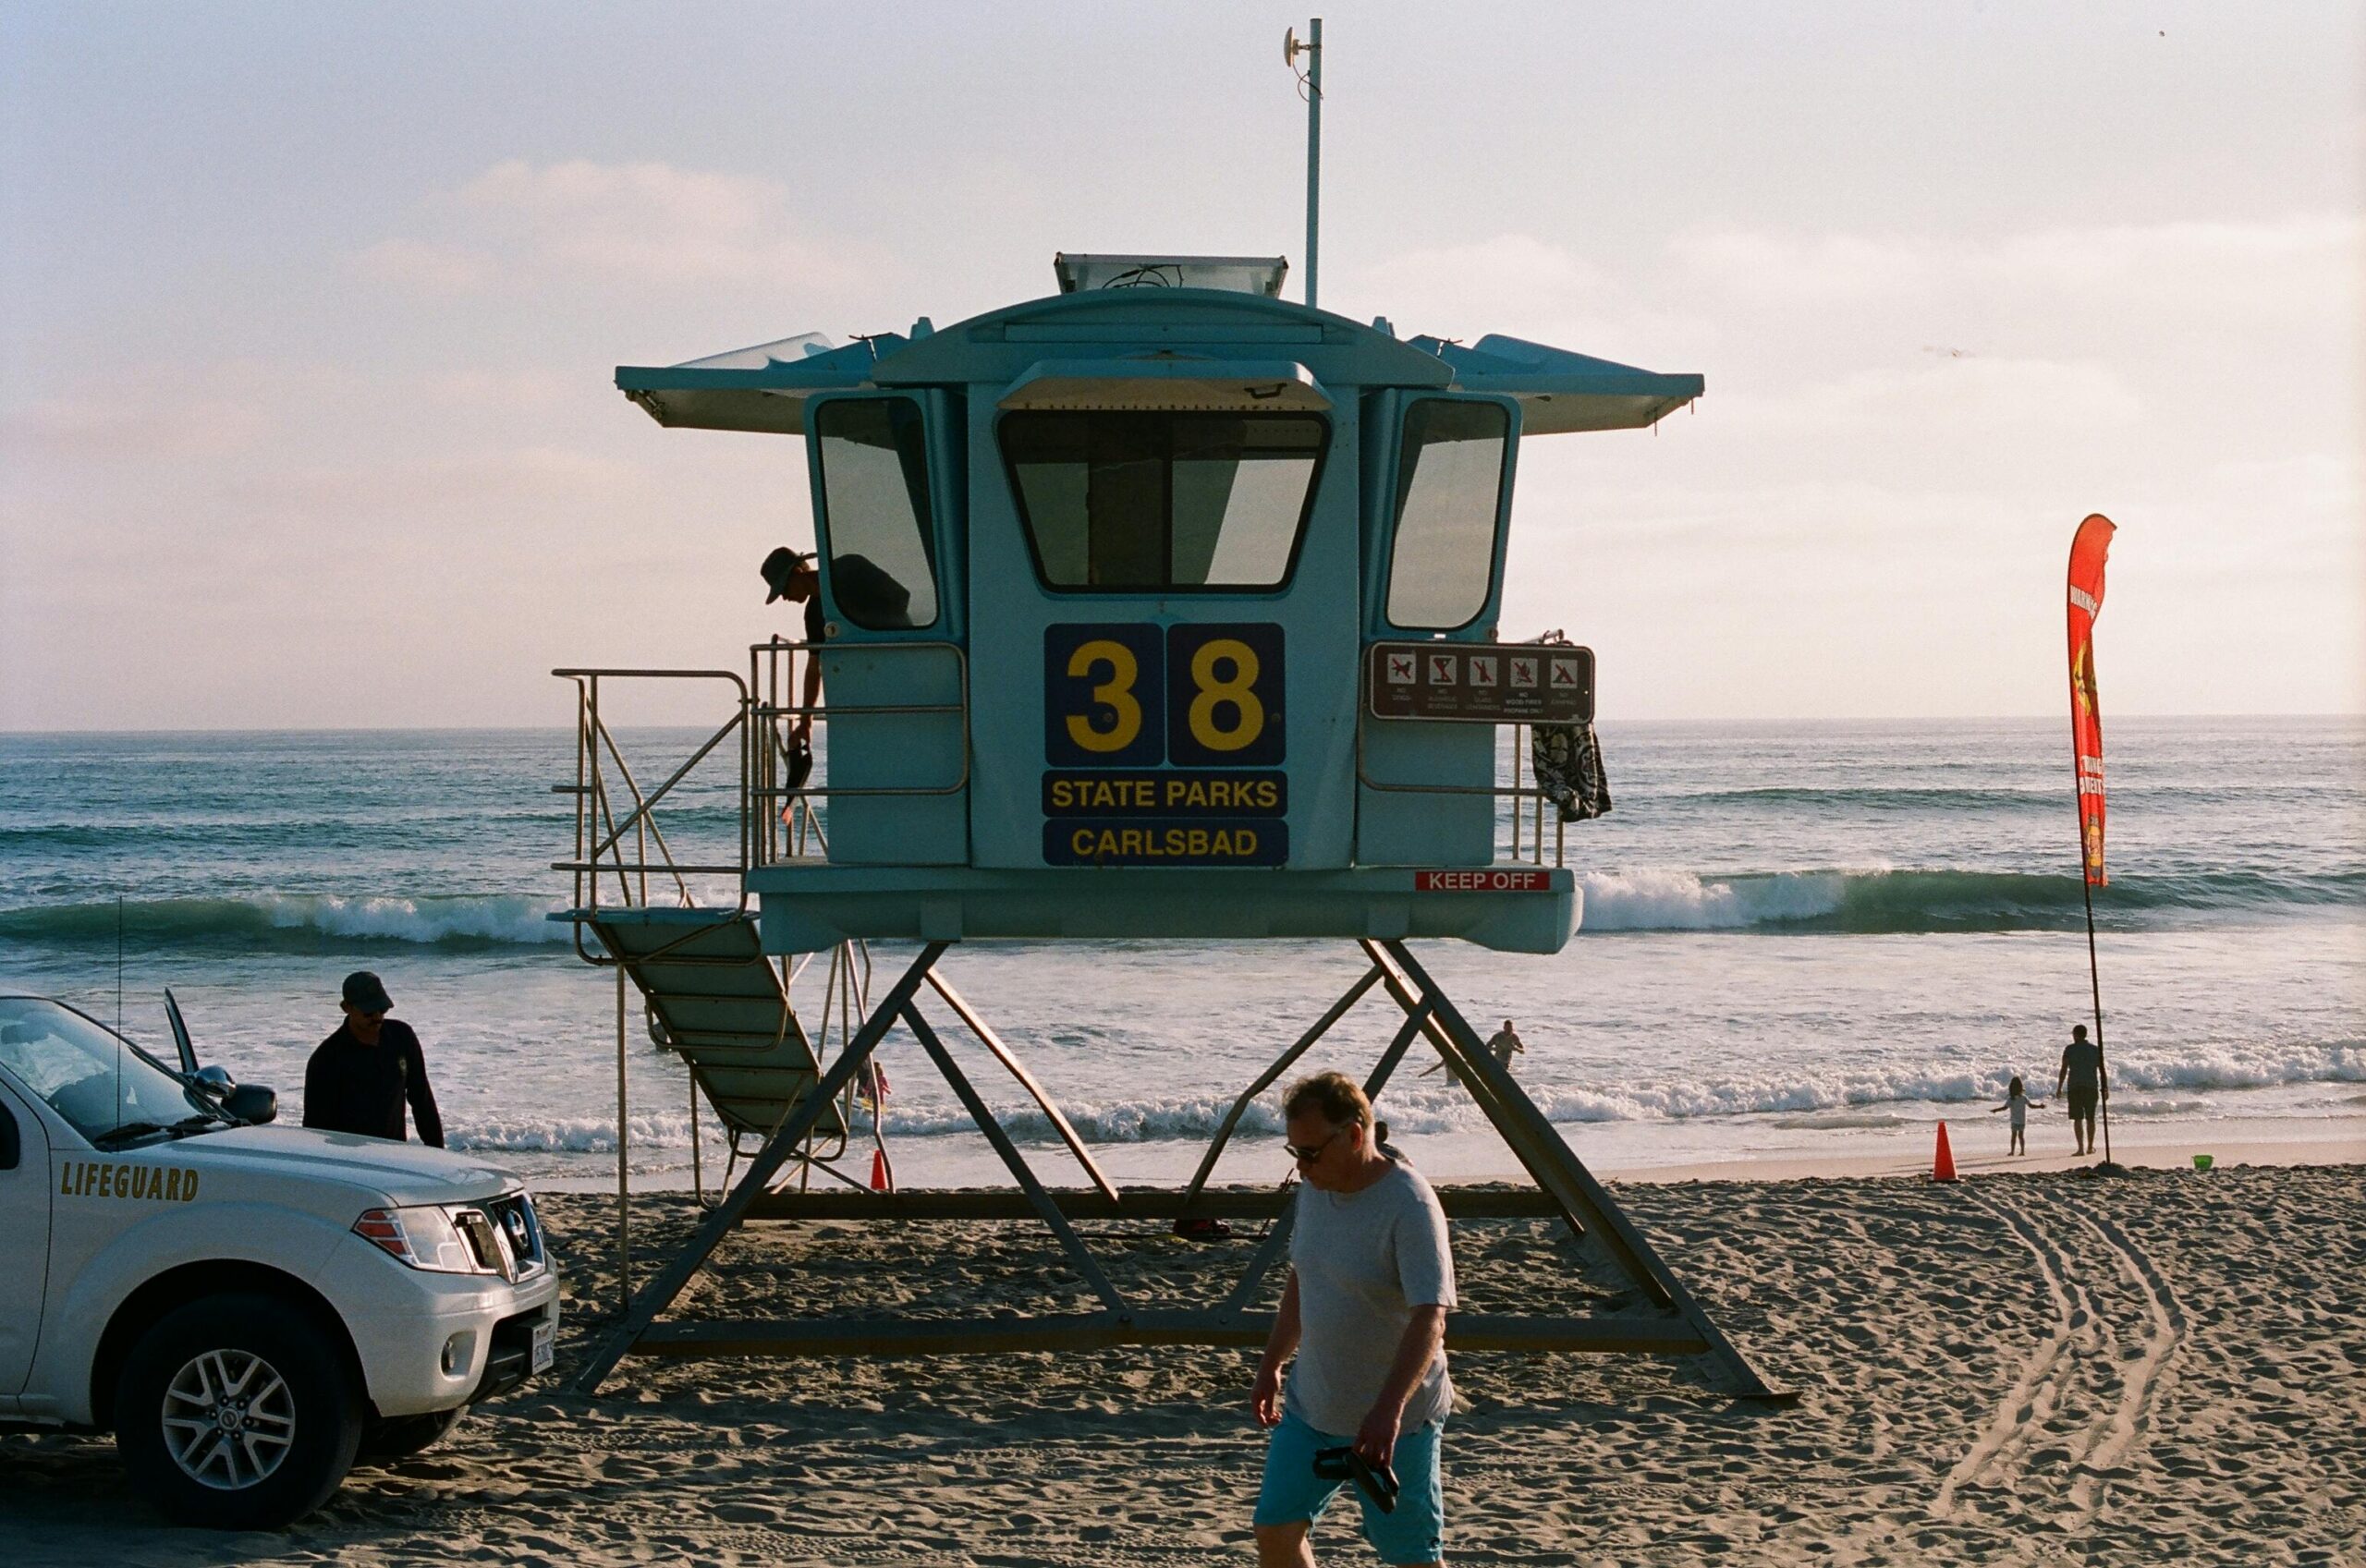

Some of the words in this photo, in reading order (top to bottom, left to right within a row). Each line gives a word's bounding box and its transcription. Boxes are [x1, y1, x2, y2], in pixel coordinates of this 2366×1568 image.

[1051, 780, 1156, 808] STATE
[1166, 780, 1278, 808] PARKS
[1071, 828, 1258, 856] CARLSBAD
[1429, 872, 1486, 890] KEEP
[1493, 872, 1536, 890] OFF
[61, 1161, 200, 1202] LIFEGUARD
